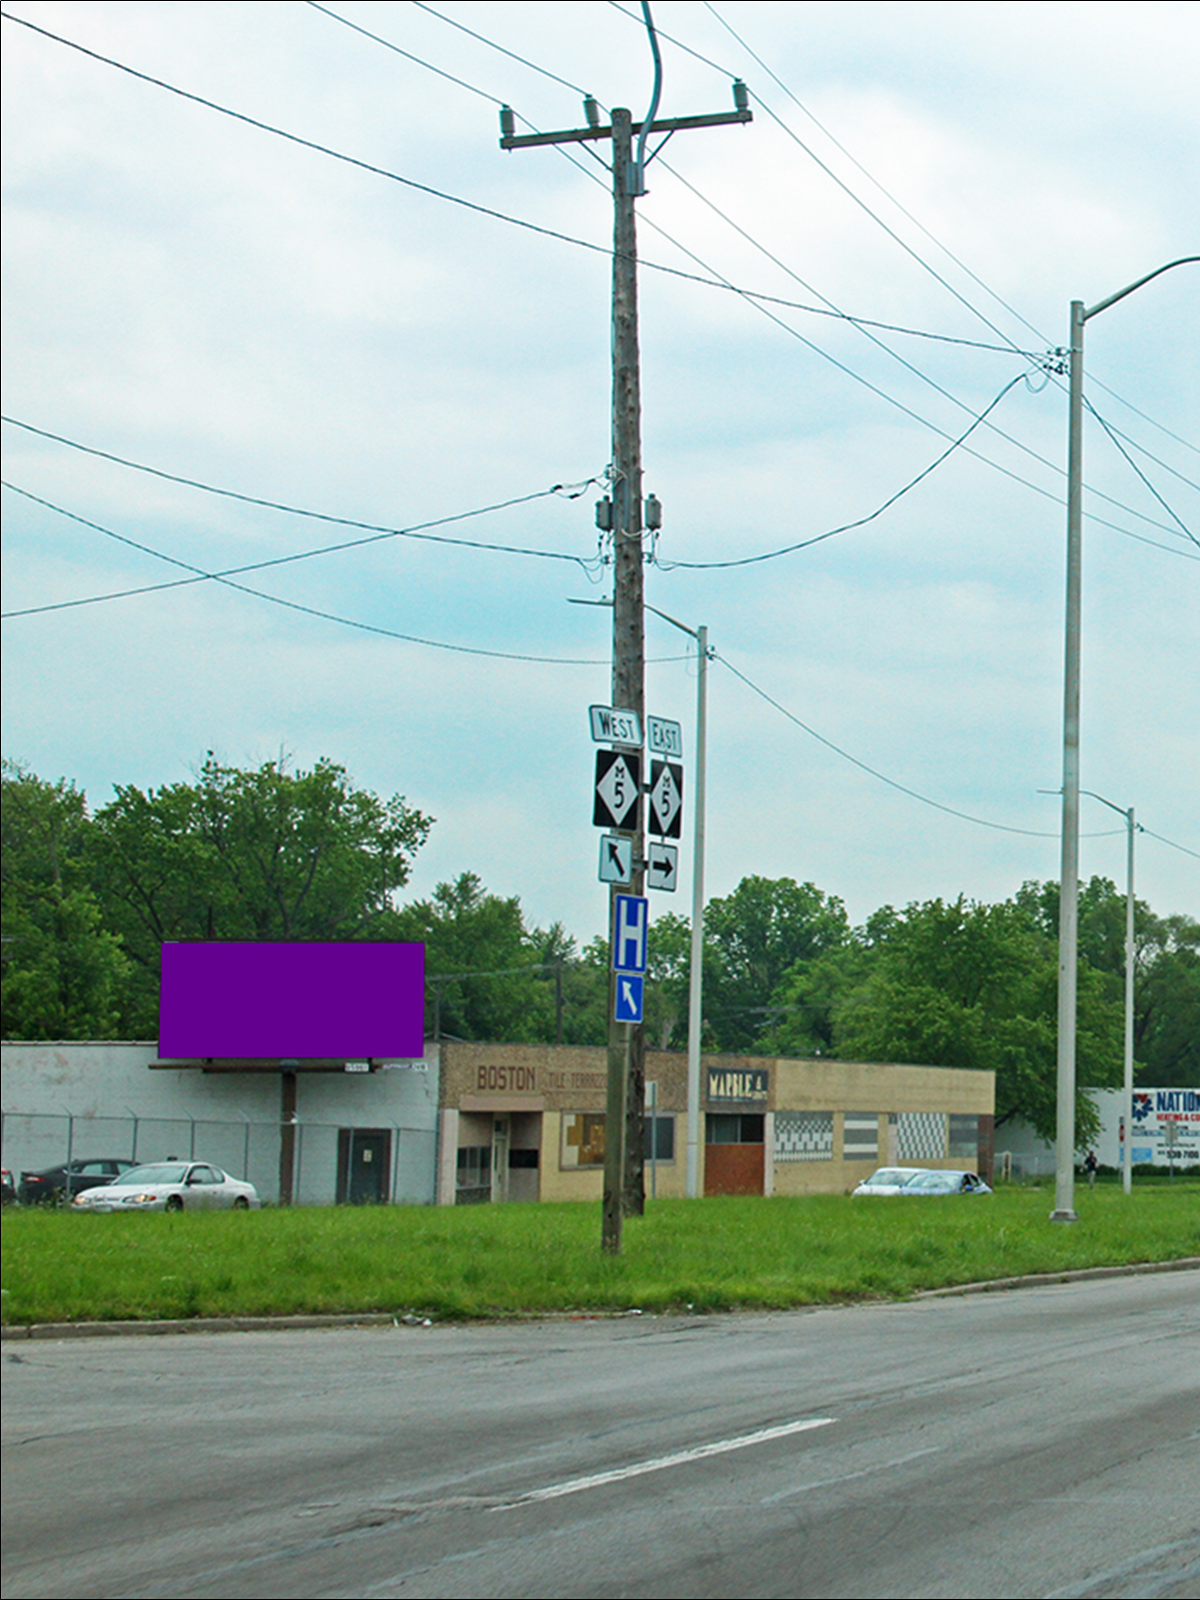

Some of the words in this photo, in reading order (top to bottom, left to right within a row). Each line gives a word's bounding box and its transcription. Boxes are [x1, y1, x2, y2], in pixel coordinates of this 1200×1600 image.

[598, 711, 635, 740] WEST
[653, 723, 677, 749] EAST
[615, 765, 625, 779] M
[662, 775, 671, 789] M
[614, 782, 625, 809] 5
[661, 791, 671, 817] 5
[618, 899, 645, 968] H
[477, 1065, 536, 1090] BOSTON
[709, 1073, 753, 1097] MARBLE
[1156, 1113, 1183, 1121] HEATING
[1184, 1113, 1190, 1121] &
